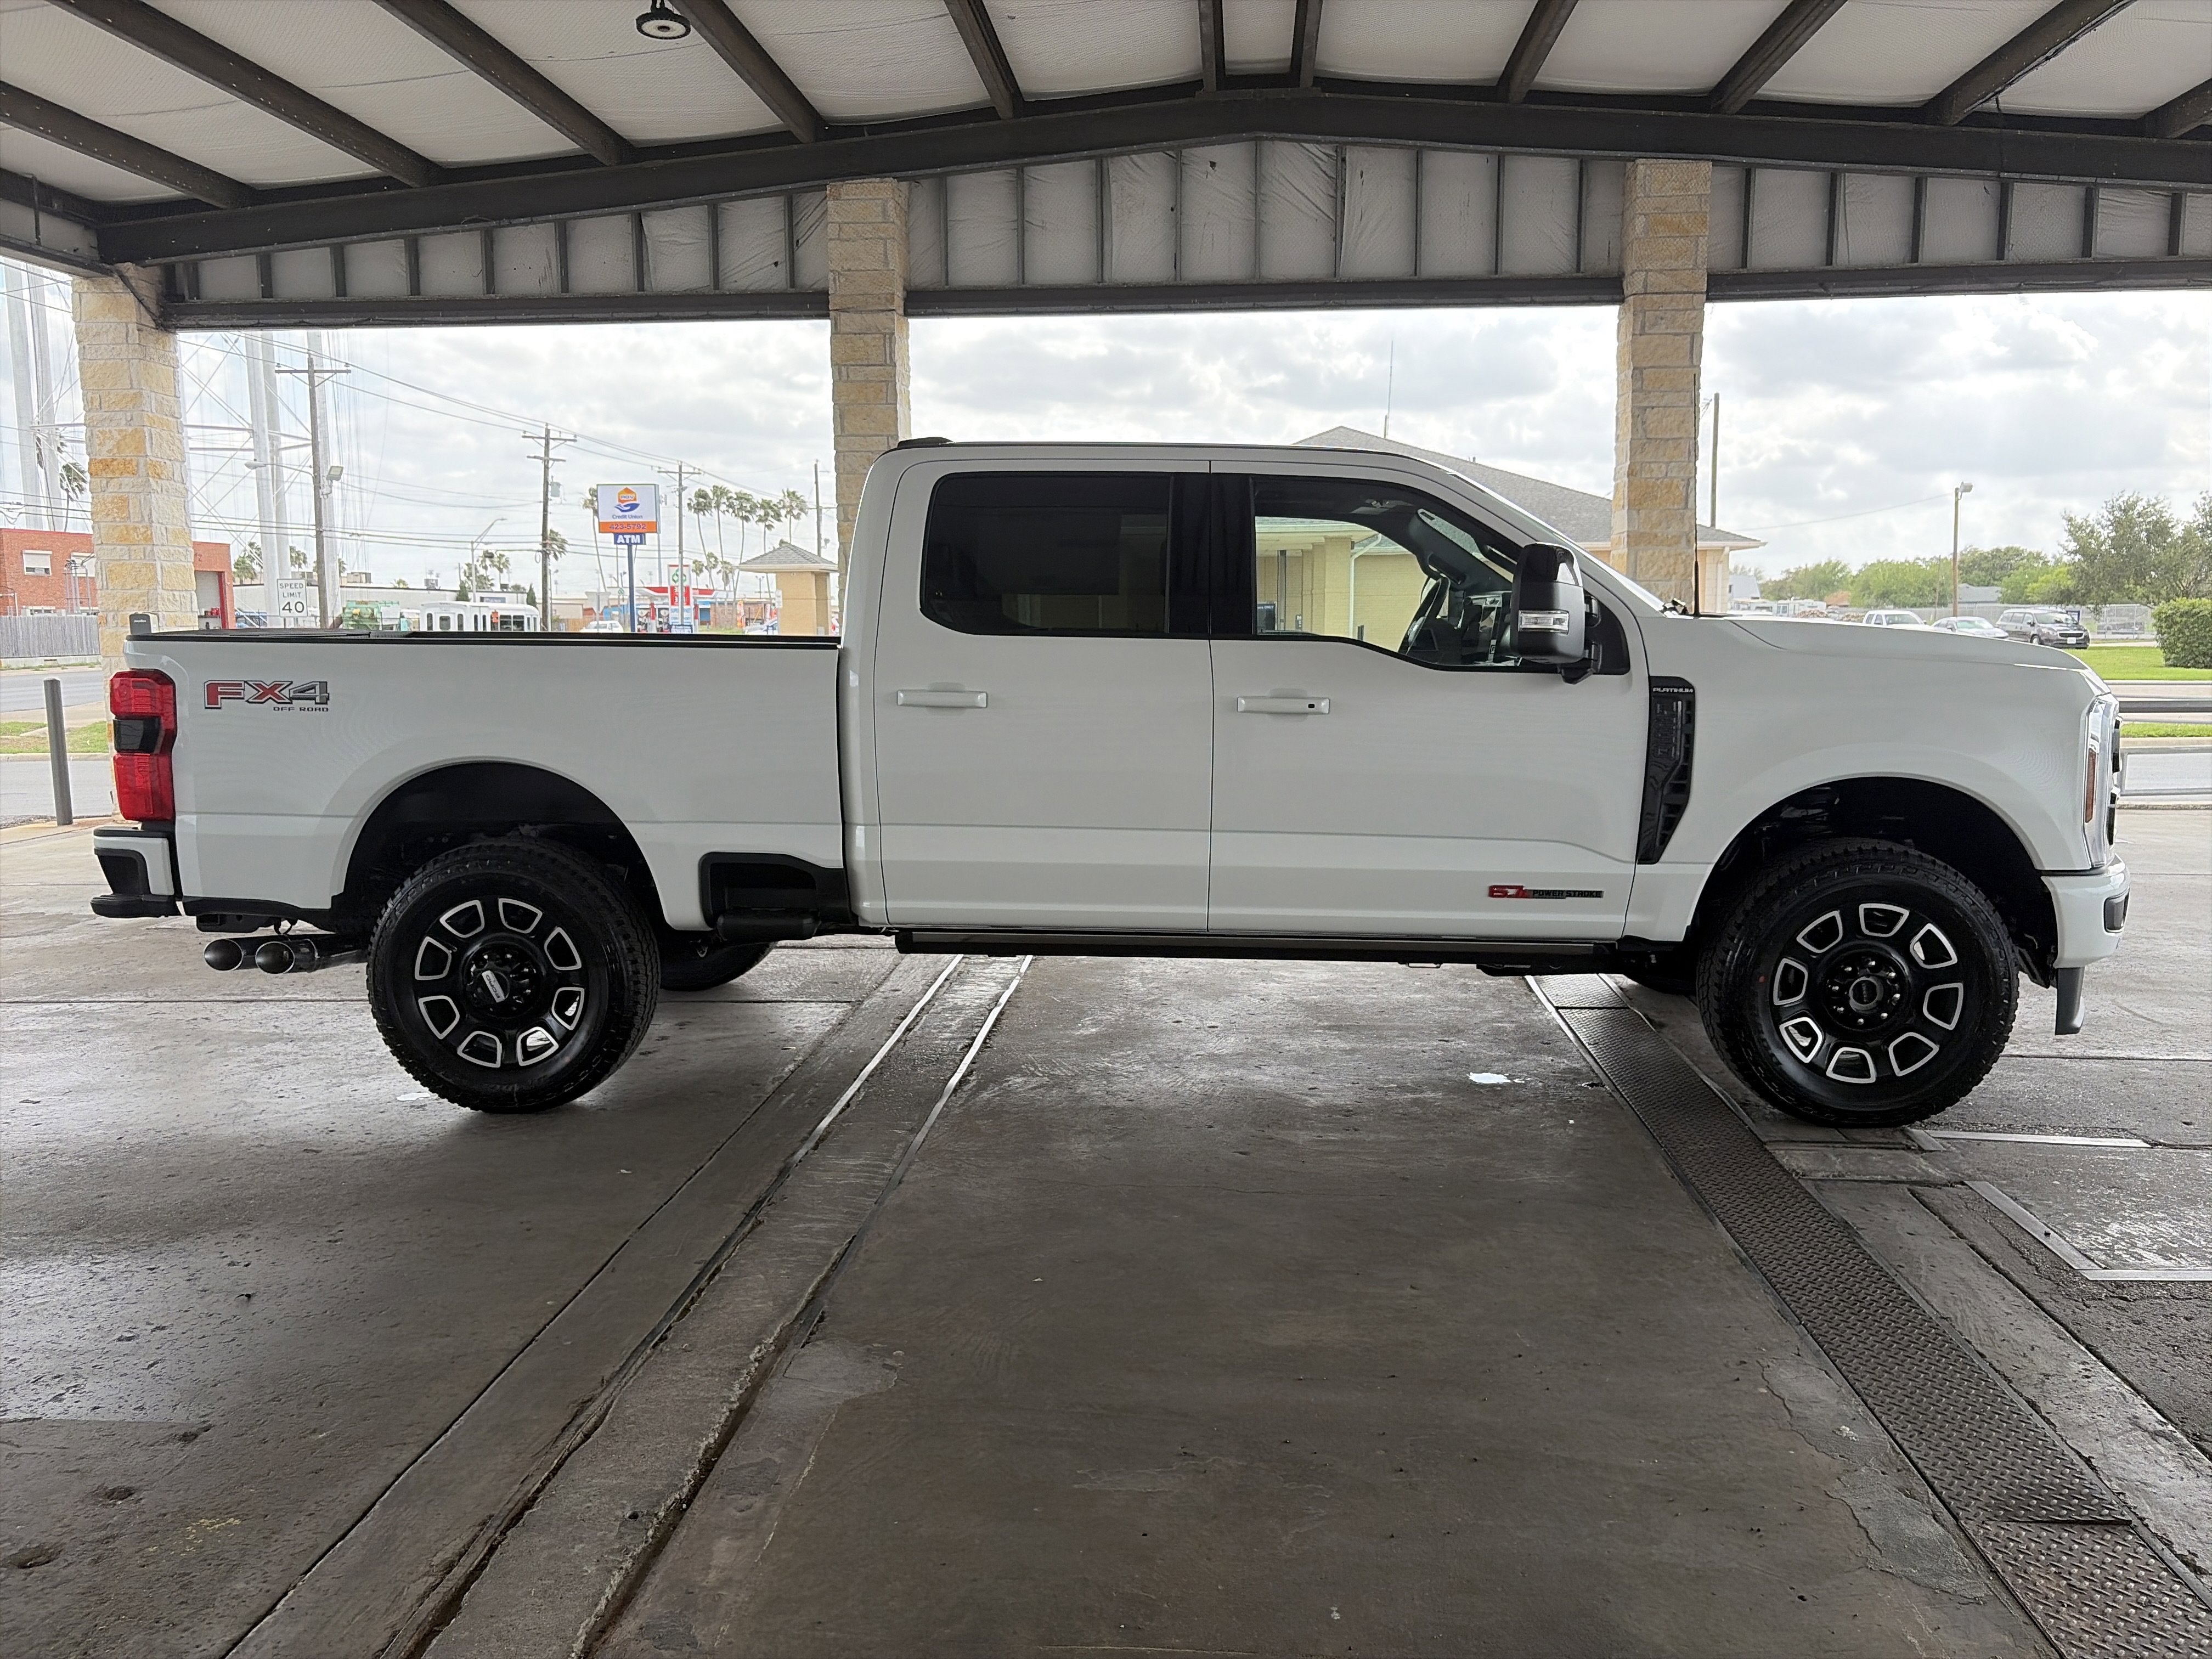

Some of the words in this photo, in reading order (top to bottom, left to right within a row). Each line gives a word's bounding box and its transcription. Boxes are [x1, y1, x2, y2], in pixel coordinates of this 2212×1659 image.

[617, 534, 640, 544] ATM
[281, 601, 304, 613] 40
[204, 680, 329, 709] FX4
[1566, 890, 1602, 898] STROKE
[486, 974, 500, 998] FORD
